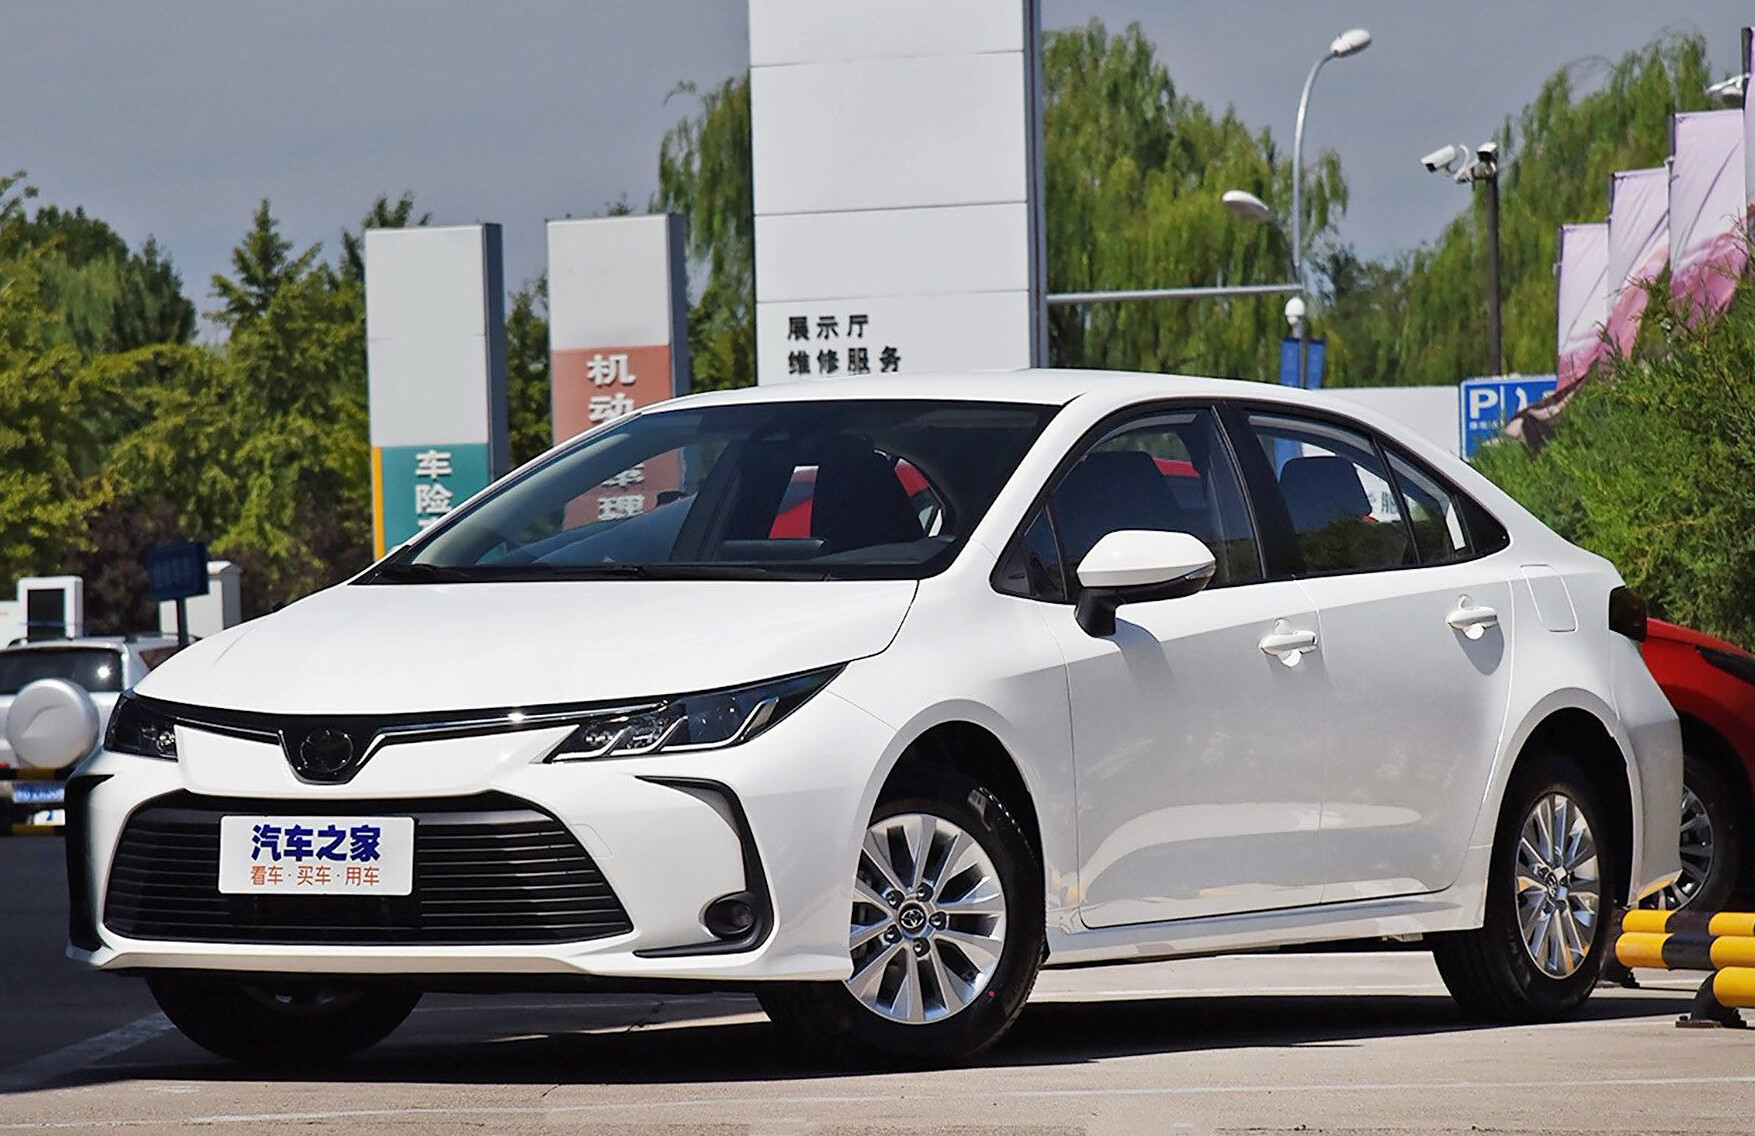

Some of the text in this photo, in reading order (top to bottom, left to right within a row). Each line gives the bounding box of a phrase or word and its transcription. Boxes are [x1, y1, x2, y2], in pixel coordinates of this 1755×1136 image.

[788, 314, 869, 341] 展示厅
[788, 345, 901, 375] 维修服务
[1469, 389, 1499, 419] P
[415, 449, 452, 530] 车险
[251, 824, 381, 862] 汽车之家
